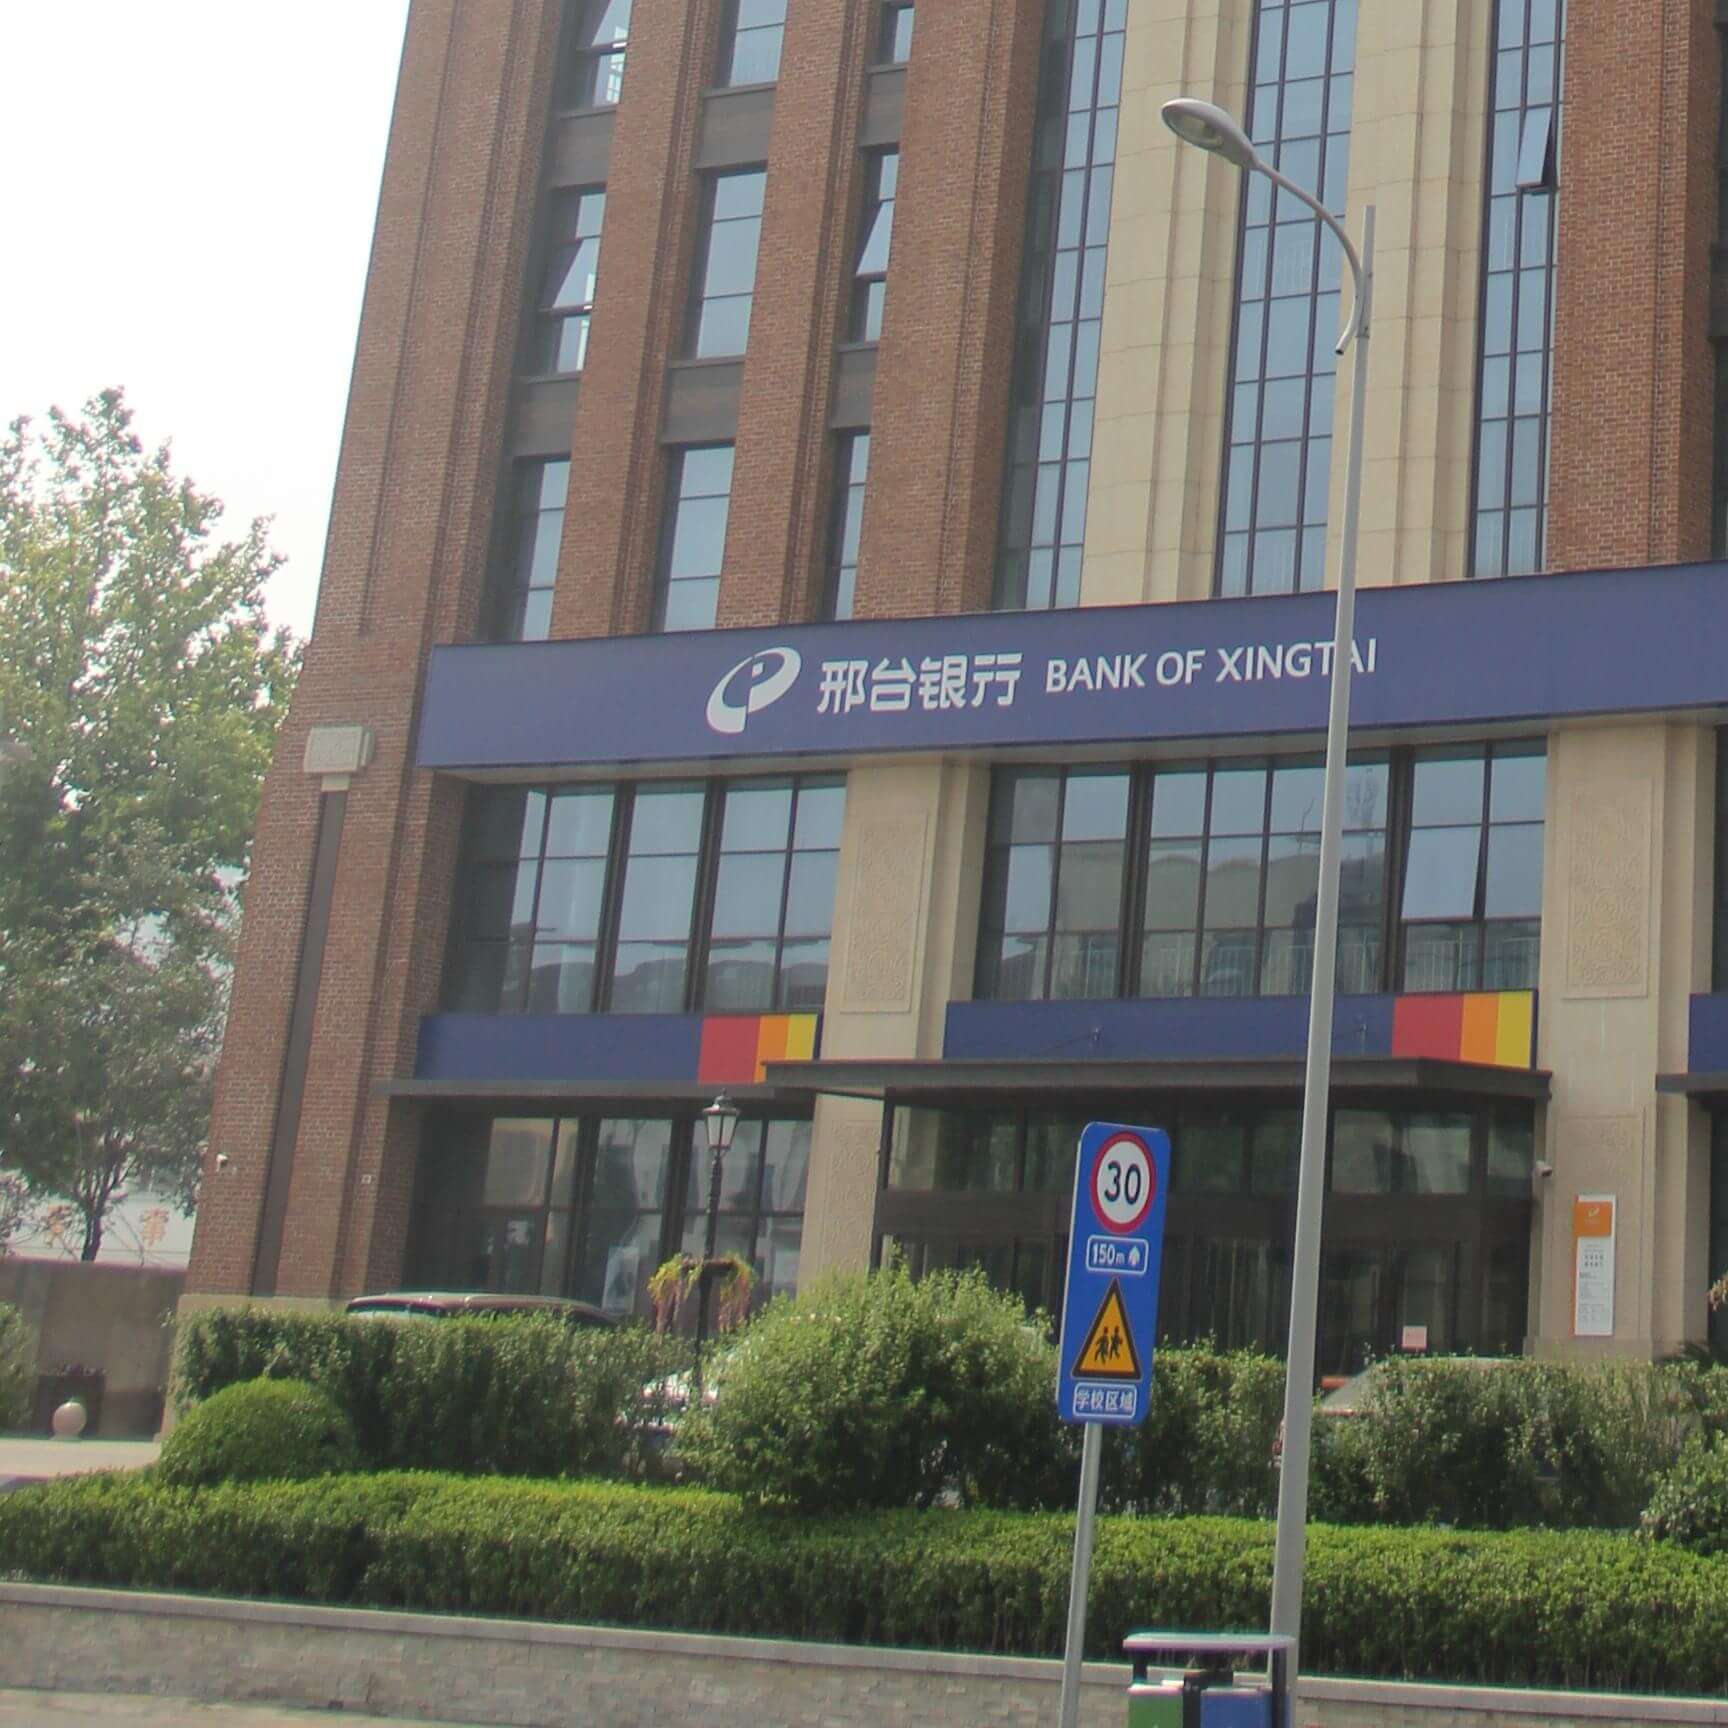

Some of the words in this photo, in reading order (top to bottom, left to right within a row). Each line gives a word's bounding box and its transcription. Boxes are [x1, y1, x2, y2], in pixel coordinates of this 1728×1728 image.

[816, 652, 1023, 714] 邢台银行
[1046, 653, 1148, 693] BANK
[1155, 649, 1205, 685] OF
[1104, 1160, 1142, 1206] 30
[1092, 1241, 1125, 1266] 150m
[1075, 1388, 1134, 1414] 学校区域
